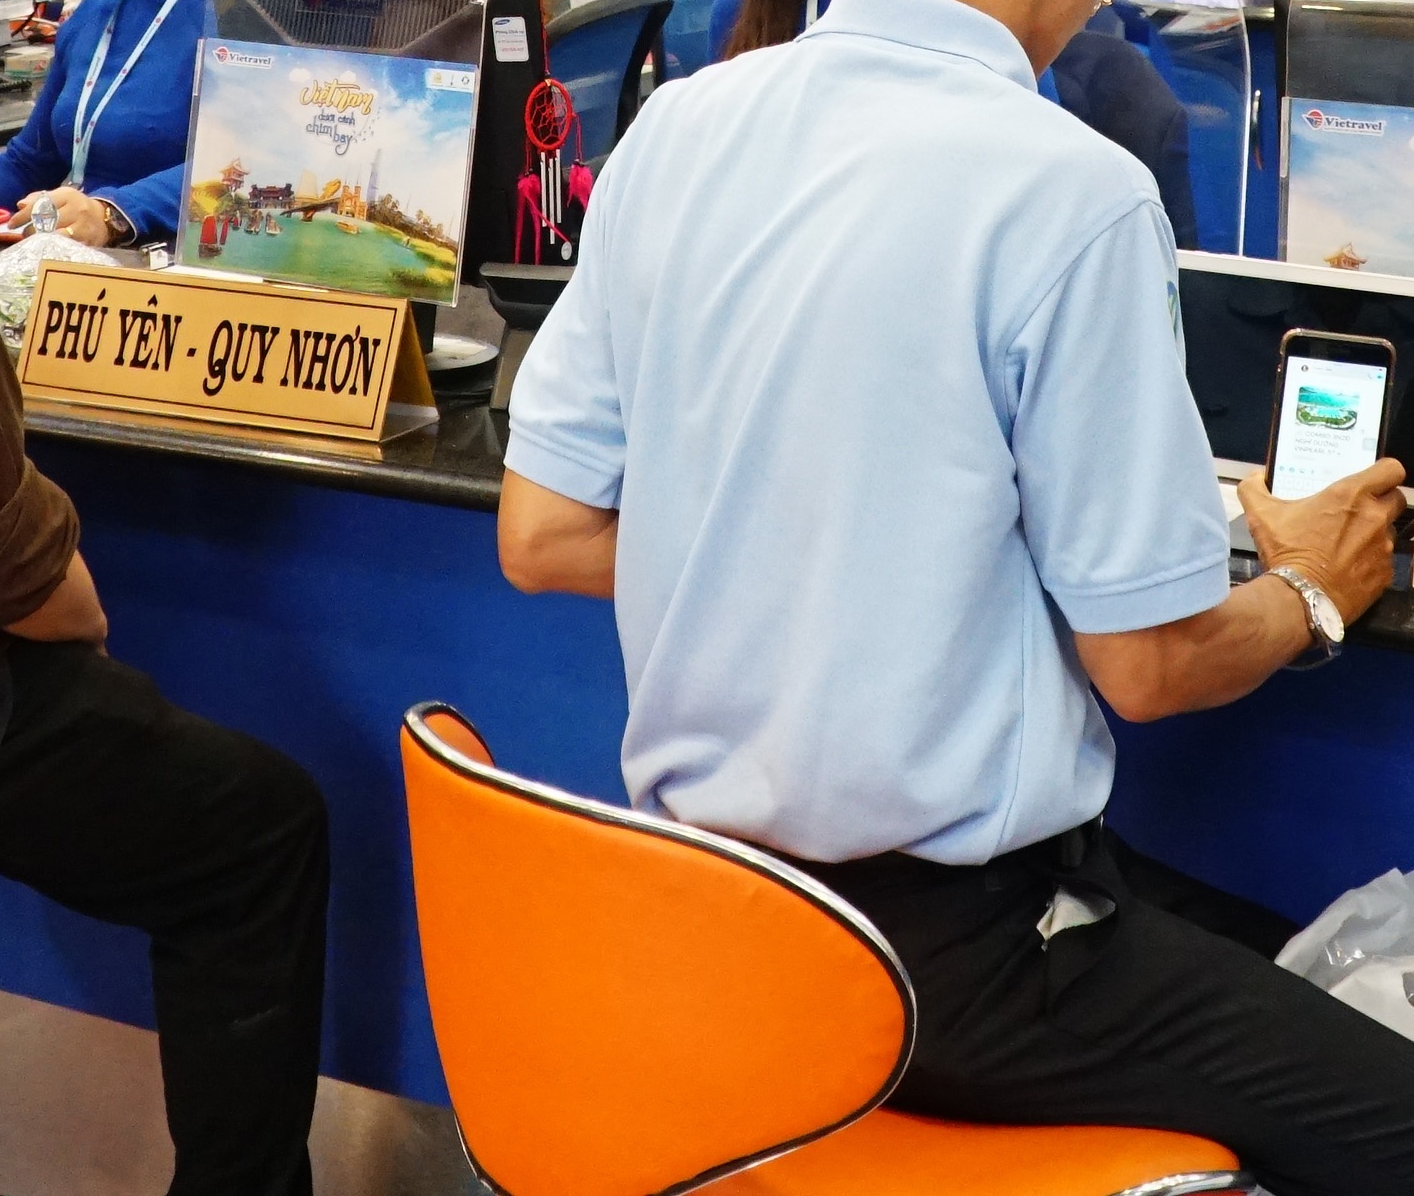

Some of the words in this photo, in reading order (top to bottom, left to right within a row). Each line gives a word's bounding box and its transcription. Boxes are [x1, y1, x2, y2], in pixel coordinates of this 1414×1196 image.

[229, 53, 272, 65] Vietravel
[334, 87, 374, 116] Nam
[1325, 116, 1382, 131] Vietravel
[37, 288, 108, 363] PHÚ
[113, 294, 183, 372] YÊN
[186, 347, 198, 358] -
[202, 320, 280, 397] QUY
[279, 325, 381, 398] NHƠN
